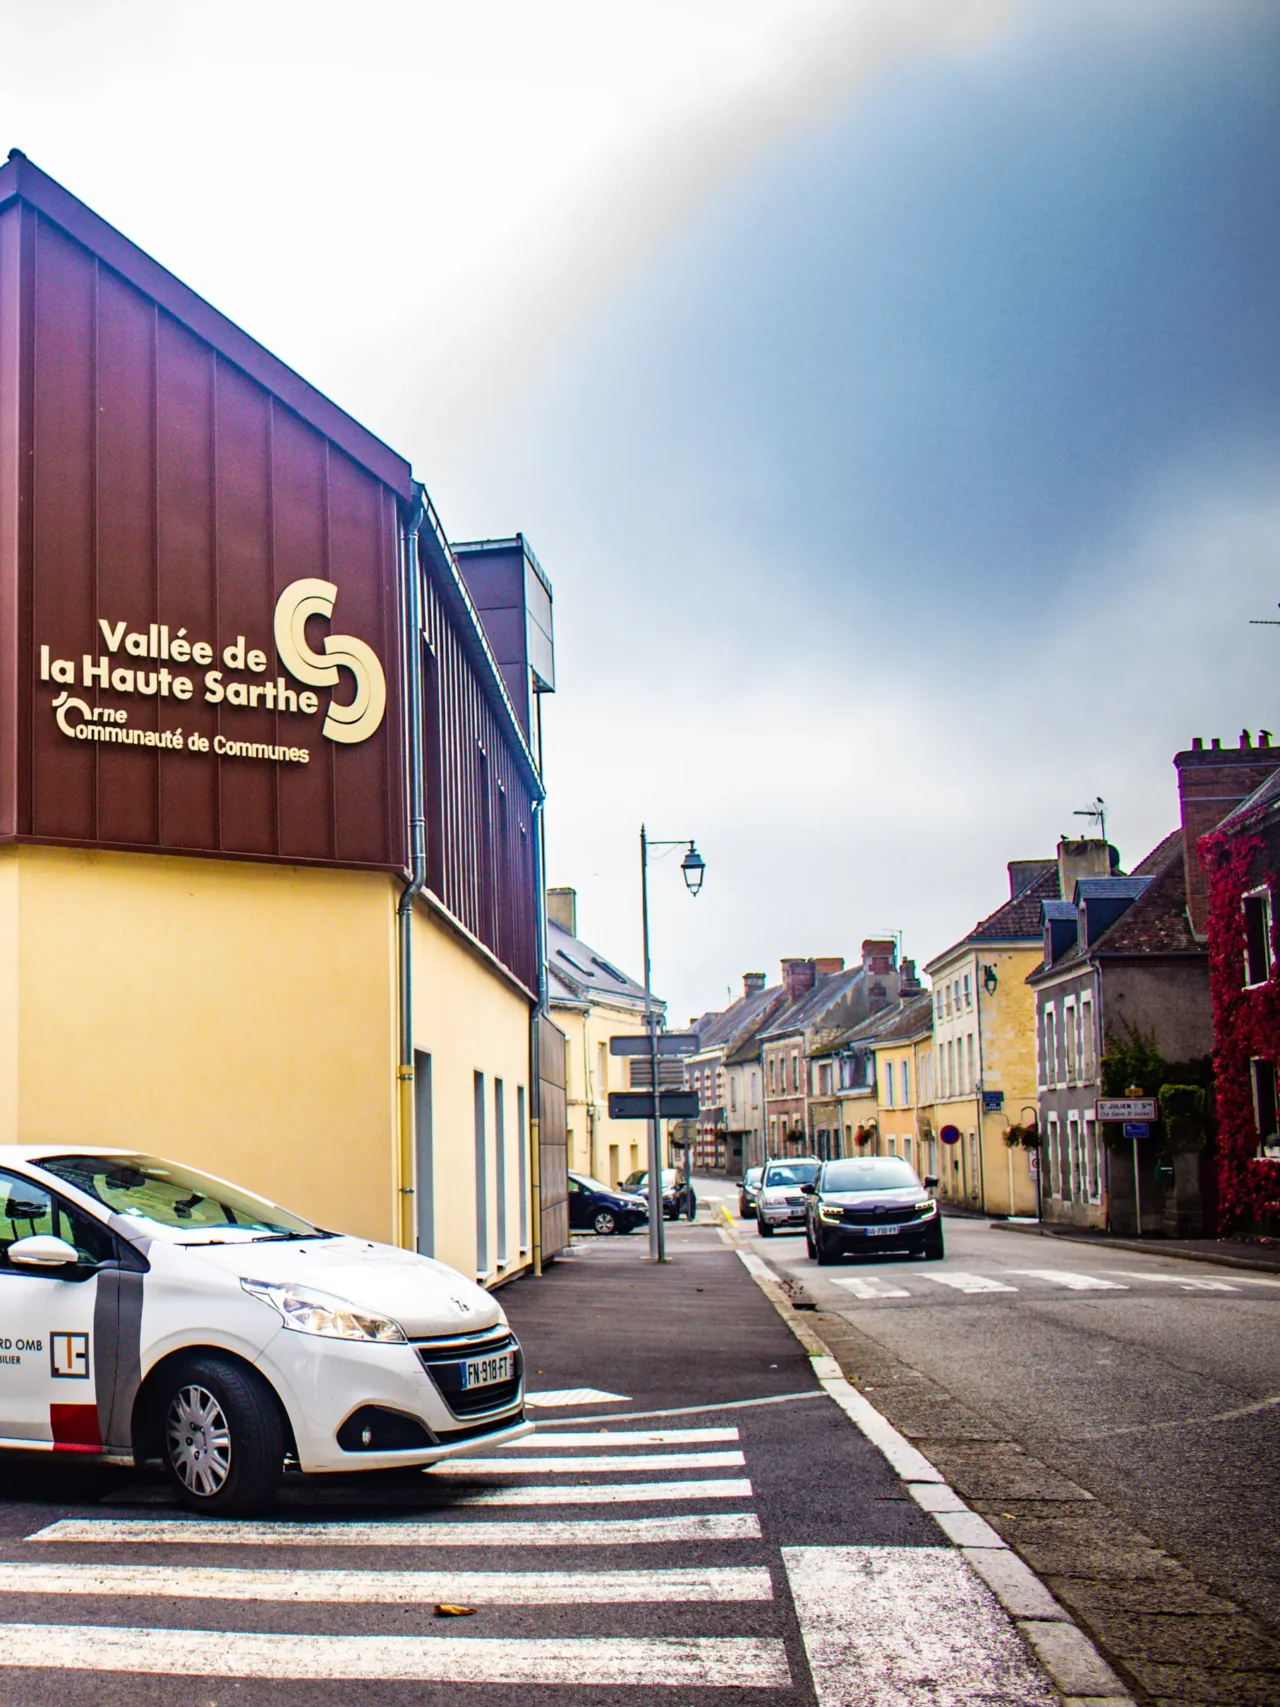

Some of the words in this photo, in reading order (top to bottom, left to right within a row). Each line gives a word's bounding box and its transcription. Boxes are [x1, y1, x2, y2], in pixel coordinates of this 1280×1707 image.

[98, 618, 213, 666] Vallée
[222, 635, 268, 673] de
[39, 644, 75, 685] la
[82, 654, 194, 701] Haute
[203, 670, 320, 715] Sarthe
[187, 731, 210, 754] de
[213, 735, 310, 764] Communes
[15, 1338, 43, 1351] OMB
[467, 1356, 508, 1386] FN-918-FT
